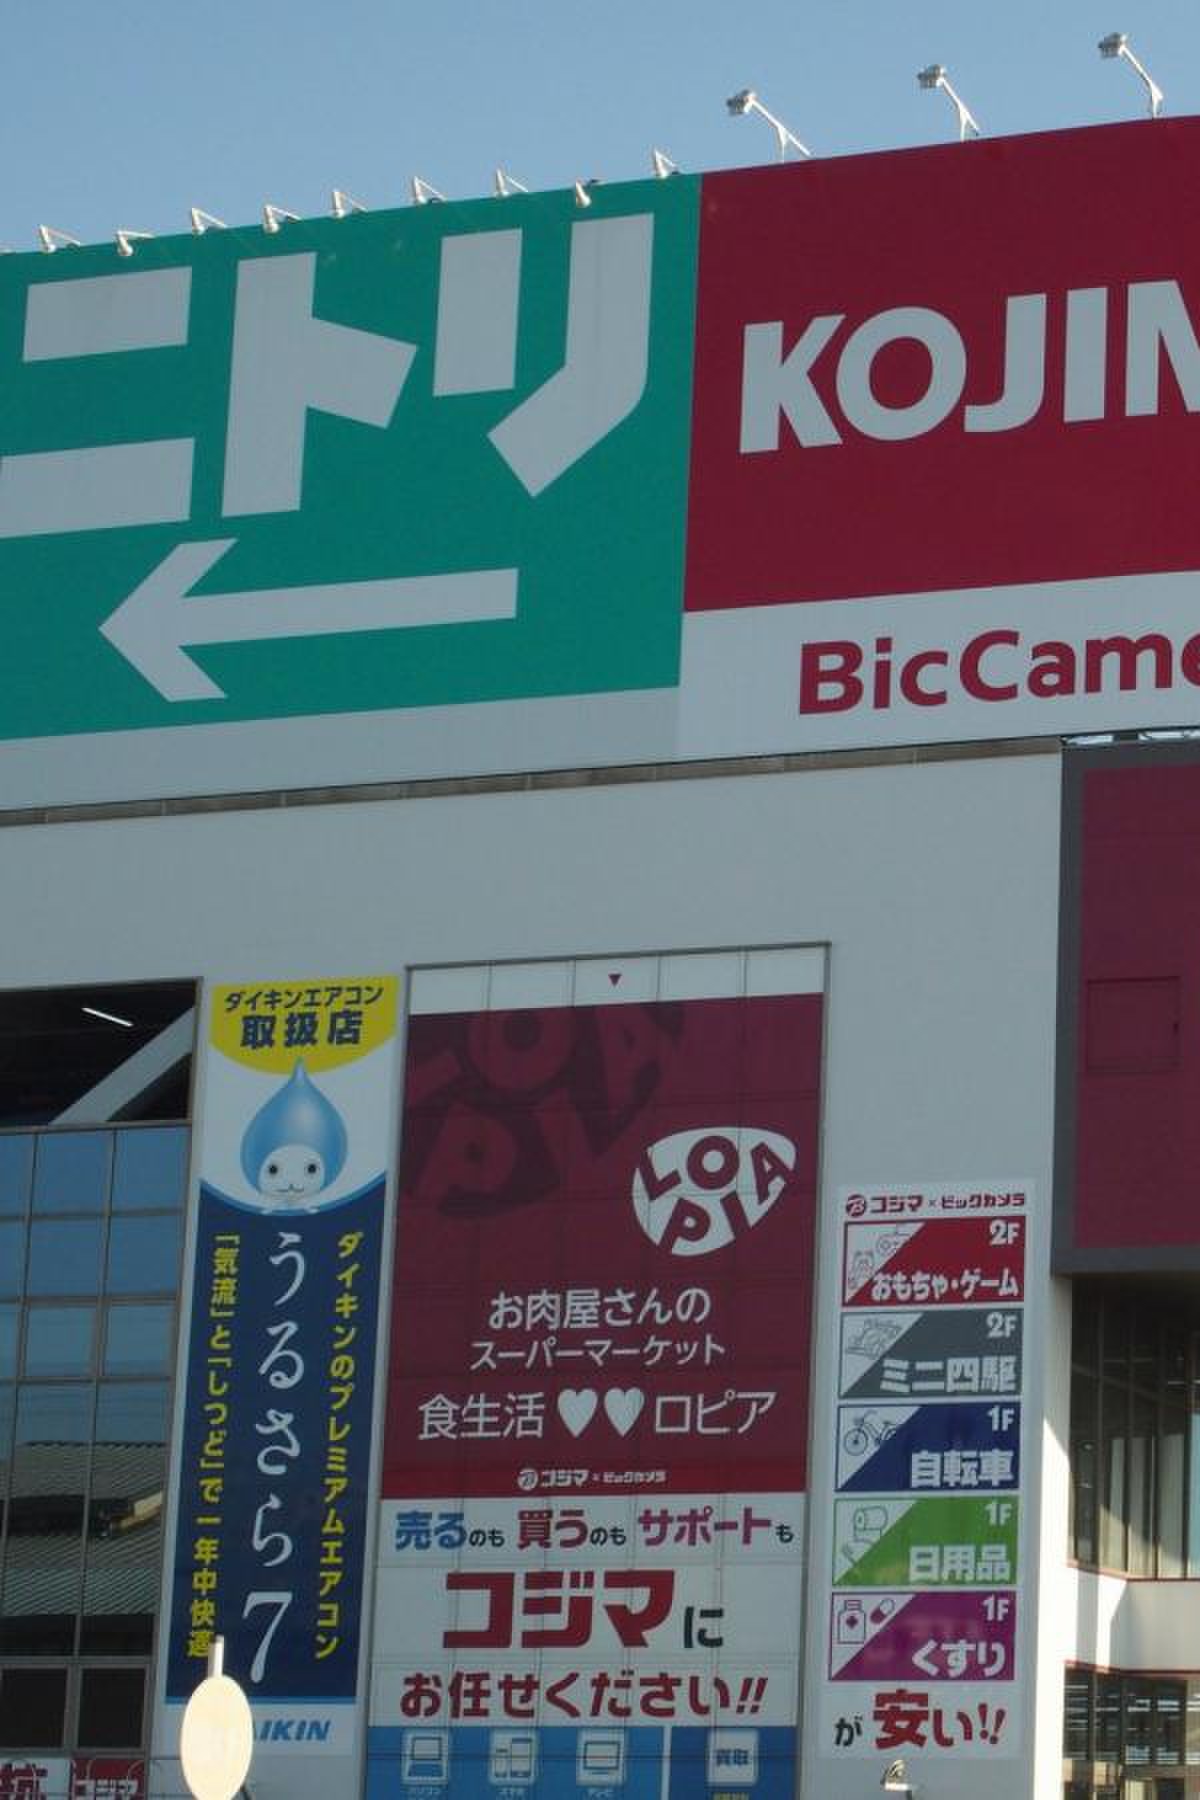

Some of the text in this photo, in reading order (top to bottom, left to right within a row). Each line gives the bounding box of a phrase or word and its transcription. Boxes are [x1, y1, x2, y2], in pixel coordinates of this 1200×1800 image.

[0, 212, 654, 538] ニトリ
[225, 985, 384, 1012] ダイキンエアコン
[240, 1010, 362, 1049] 取扱店
[989, 1219, 1020, 1246] 2F
[871, 1268, 1019, 1301] おもちゃ・ゲーム
[489, 1287, 711, 1330] お肉屋さんの
[986, 1313, 1017, 1338] 2F
[470, 1333, 726, 1372] スーパーマーケット
[880, 1355, 1016, 1393] ミニ四駆
[417, 1389, 778, 1442] 食生活 ロピア
[987, 1407, 1015, 1432] 1F
[243, 1231, 305, 1683] うるさら7
[315, 1230, 362, 1659] ダイキンのプレミアムエアコン
[910, 1449, 1013, 1488] 自転車
[395, 1505, 794, 1551] 売るのも 買うのも サポートも
[985, 1501, 1012, 1525] 1F
[908, 1544, 1011, 1582] 日用品
[443, 1569, 725, 1650] コジマに
[982, 1595, 1009, 1621] 1F
[911, 1640, 1006, 1677] くすり
[254, 1718, 332, 1742] IKIN
